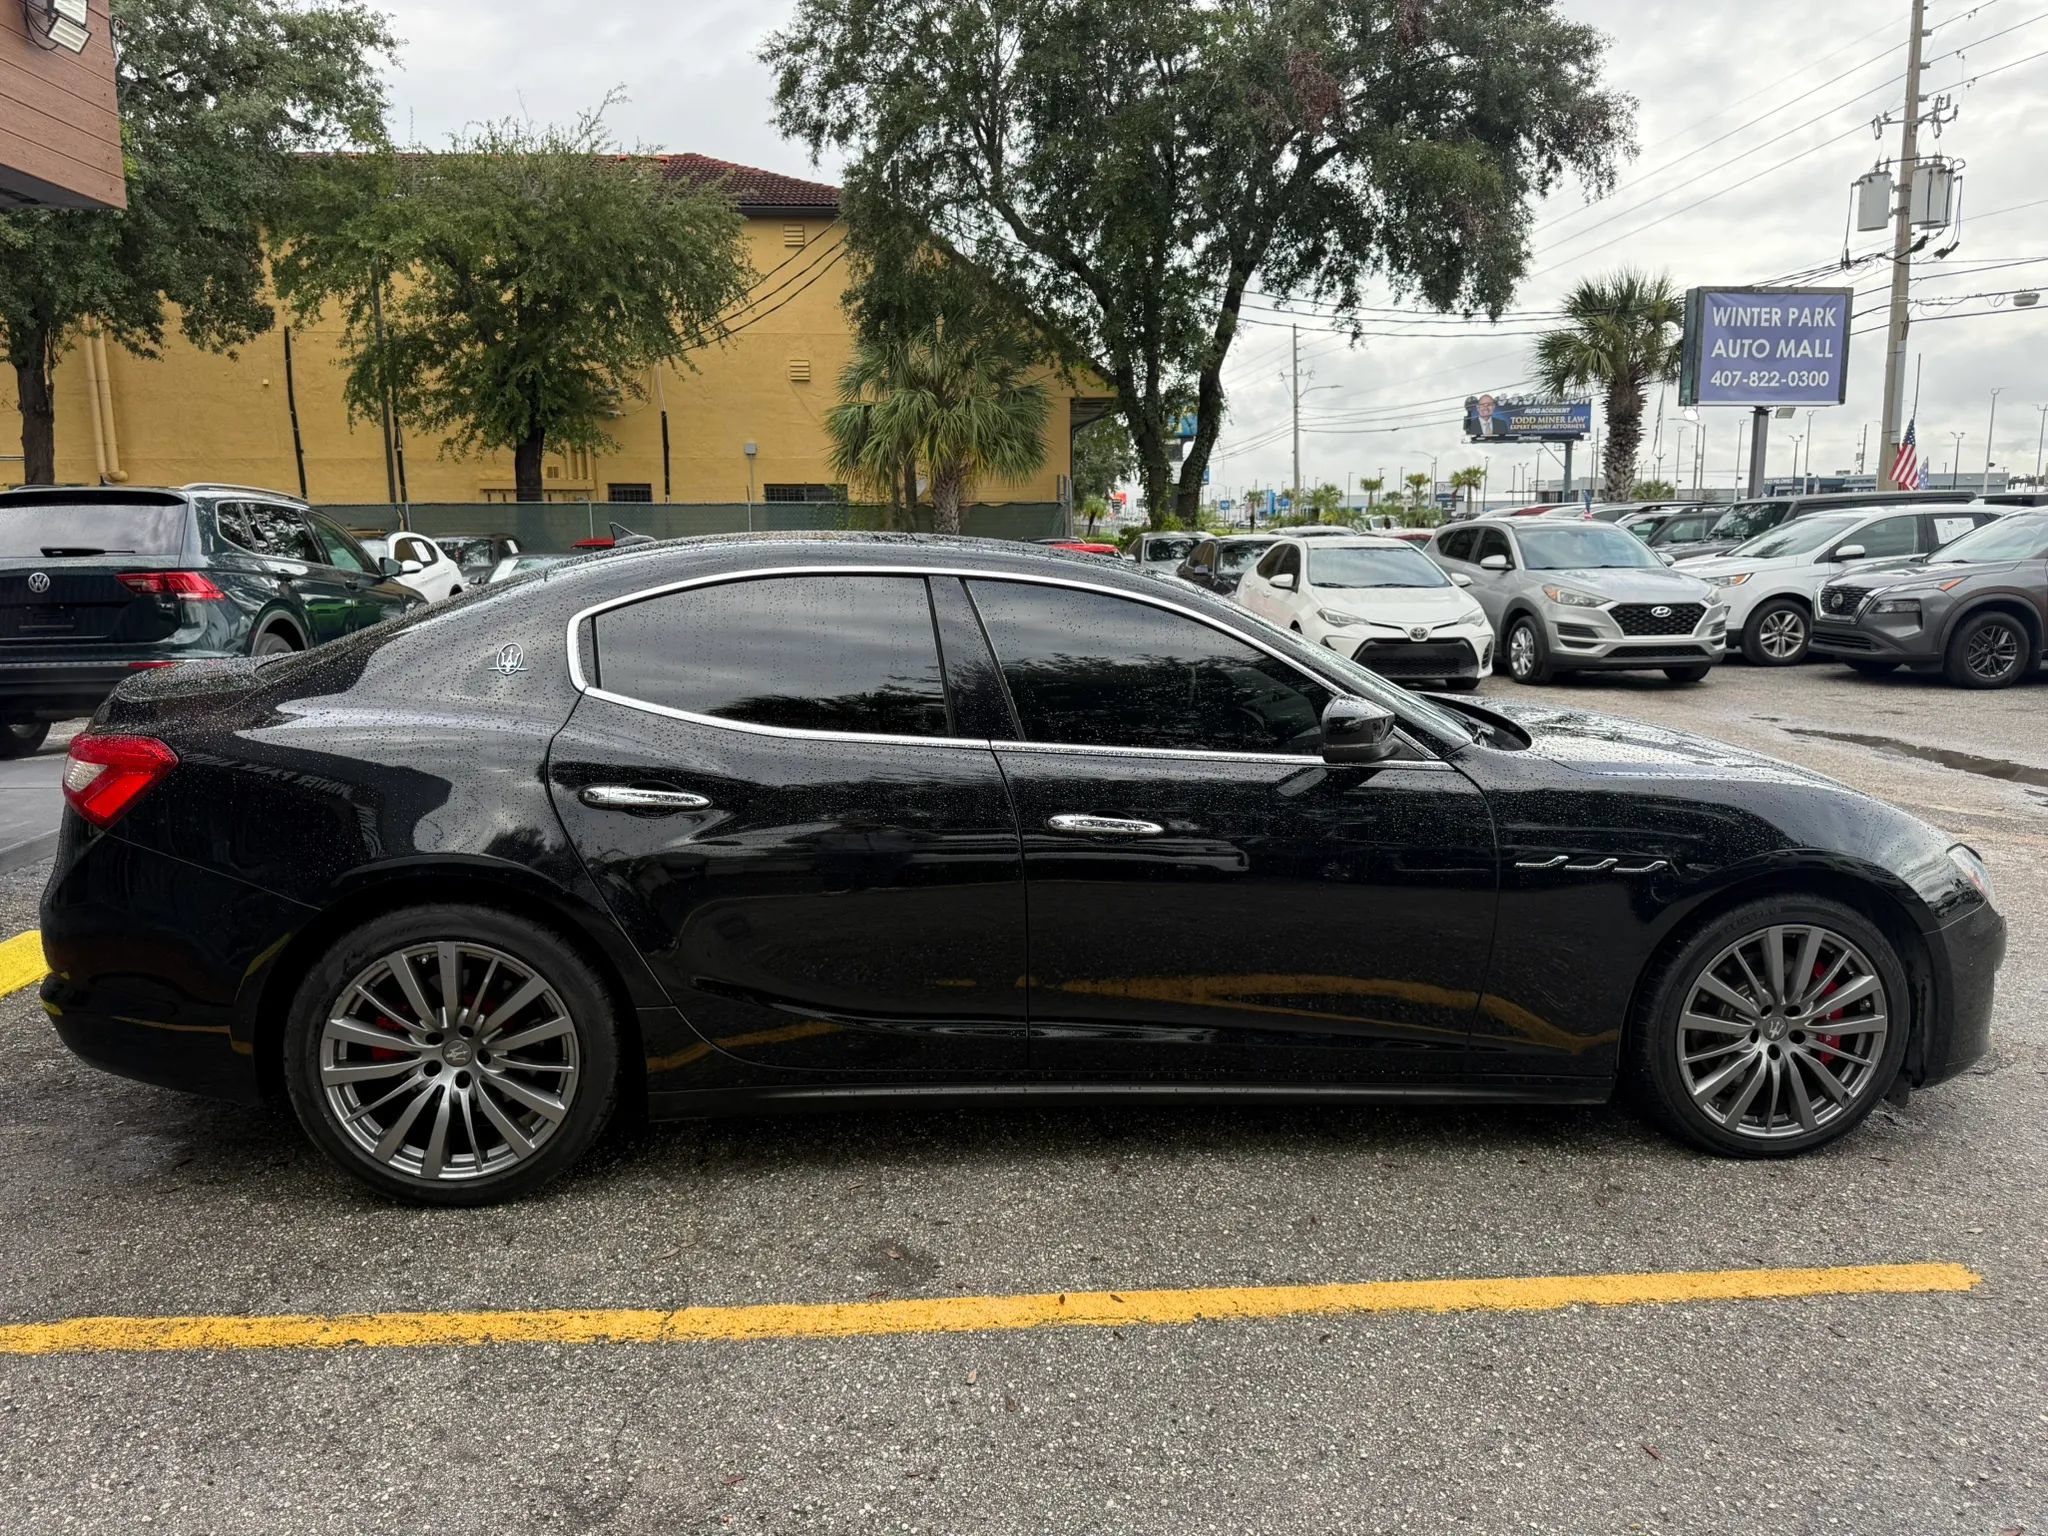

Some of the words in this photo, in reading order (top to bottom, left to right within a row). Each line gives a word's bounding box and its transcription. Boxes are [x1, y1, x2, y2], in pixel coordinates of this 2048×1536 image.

[1713, 307, 1781, 327] WINTER
[1788, 307, 1837, 327] PARK
[1711, 339, 1770, 359] AUTO
[1776, 339, 1833, 358] MALL
[1711, 371, 1829, 387] 407-822-0300
[1511, 416, 1536, 424] TODD
[1537, 416, 1566, 424] MINER
